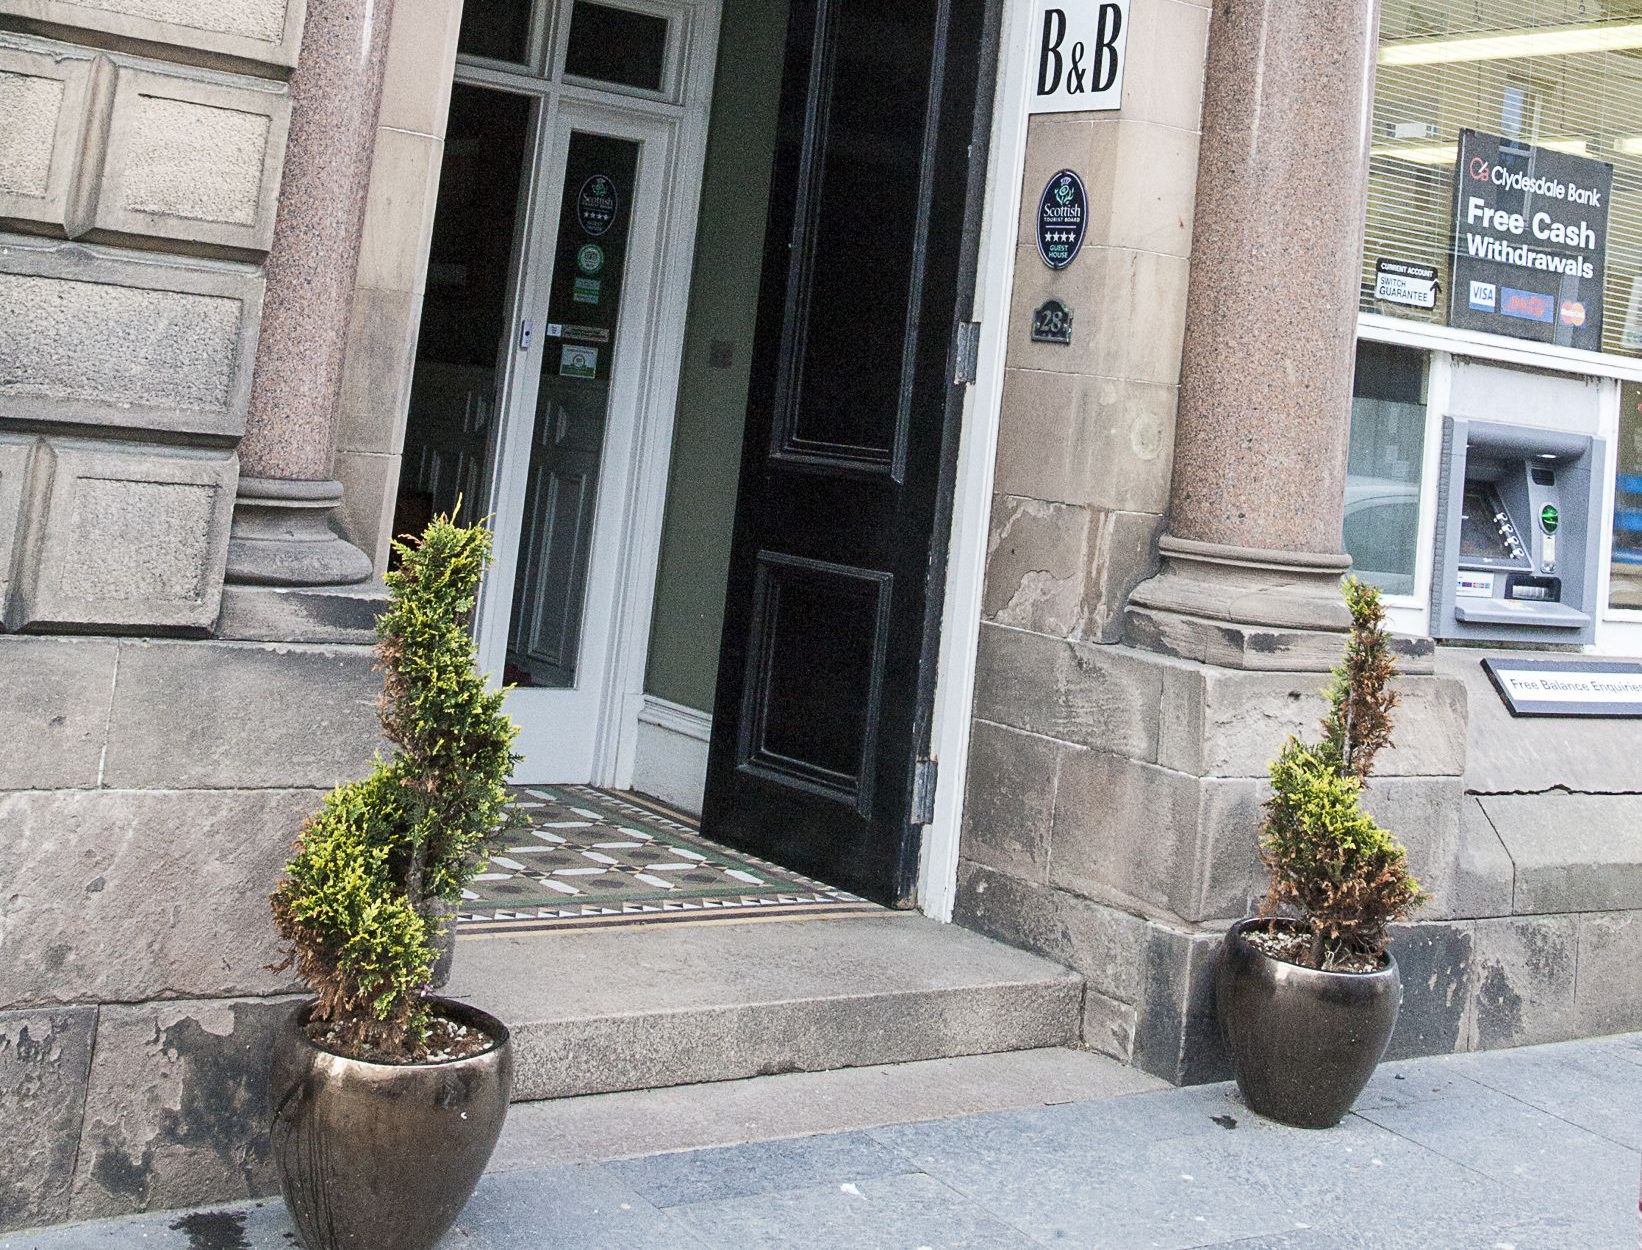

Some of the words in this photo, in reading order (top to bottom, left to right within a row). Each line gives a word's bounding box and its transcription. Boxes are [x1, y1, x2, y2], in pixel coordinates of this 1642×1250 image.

[1491, 165, 1566, 200] Clydesdale
[1567, 182, 1601, 207] Bank
[1043, 203, 1081, 217] Scottish
[1467, 196, 1525, 235] Free
[1532, 211, 1596, 250] Cash
[1048, 251, 1068, 259] HOUSE
[1049, 244, 1069, 252] GUEST
[1466, 232, 1594, 279] Withdrawals
[1407, 267, 1434, 278] ACCOUNT
[1379, 285, 1428, 302] GUARANTEE
[1473, 286, 1494, 301] VISA
[1039, 310, 1063, 333] 28
[1510, 678, 1539, 690] Free
[1540, 679, 1590, 691] Balance
